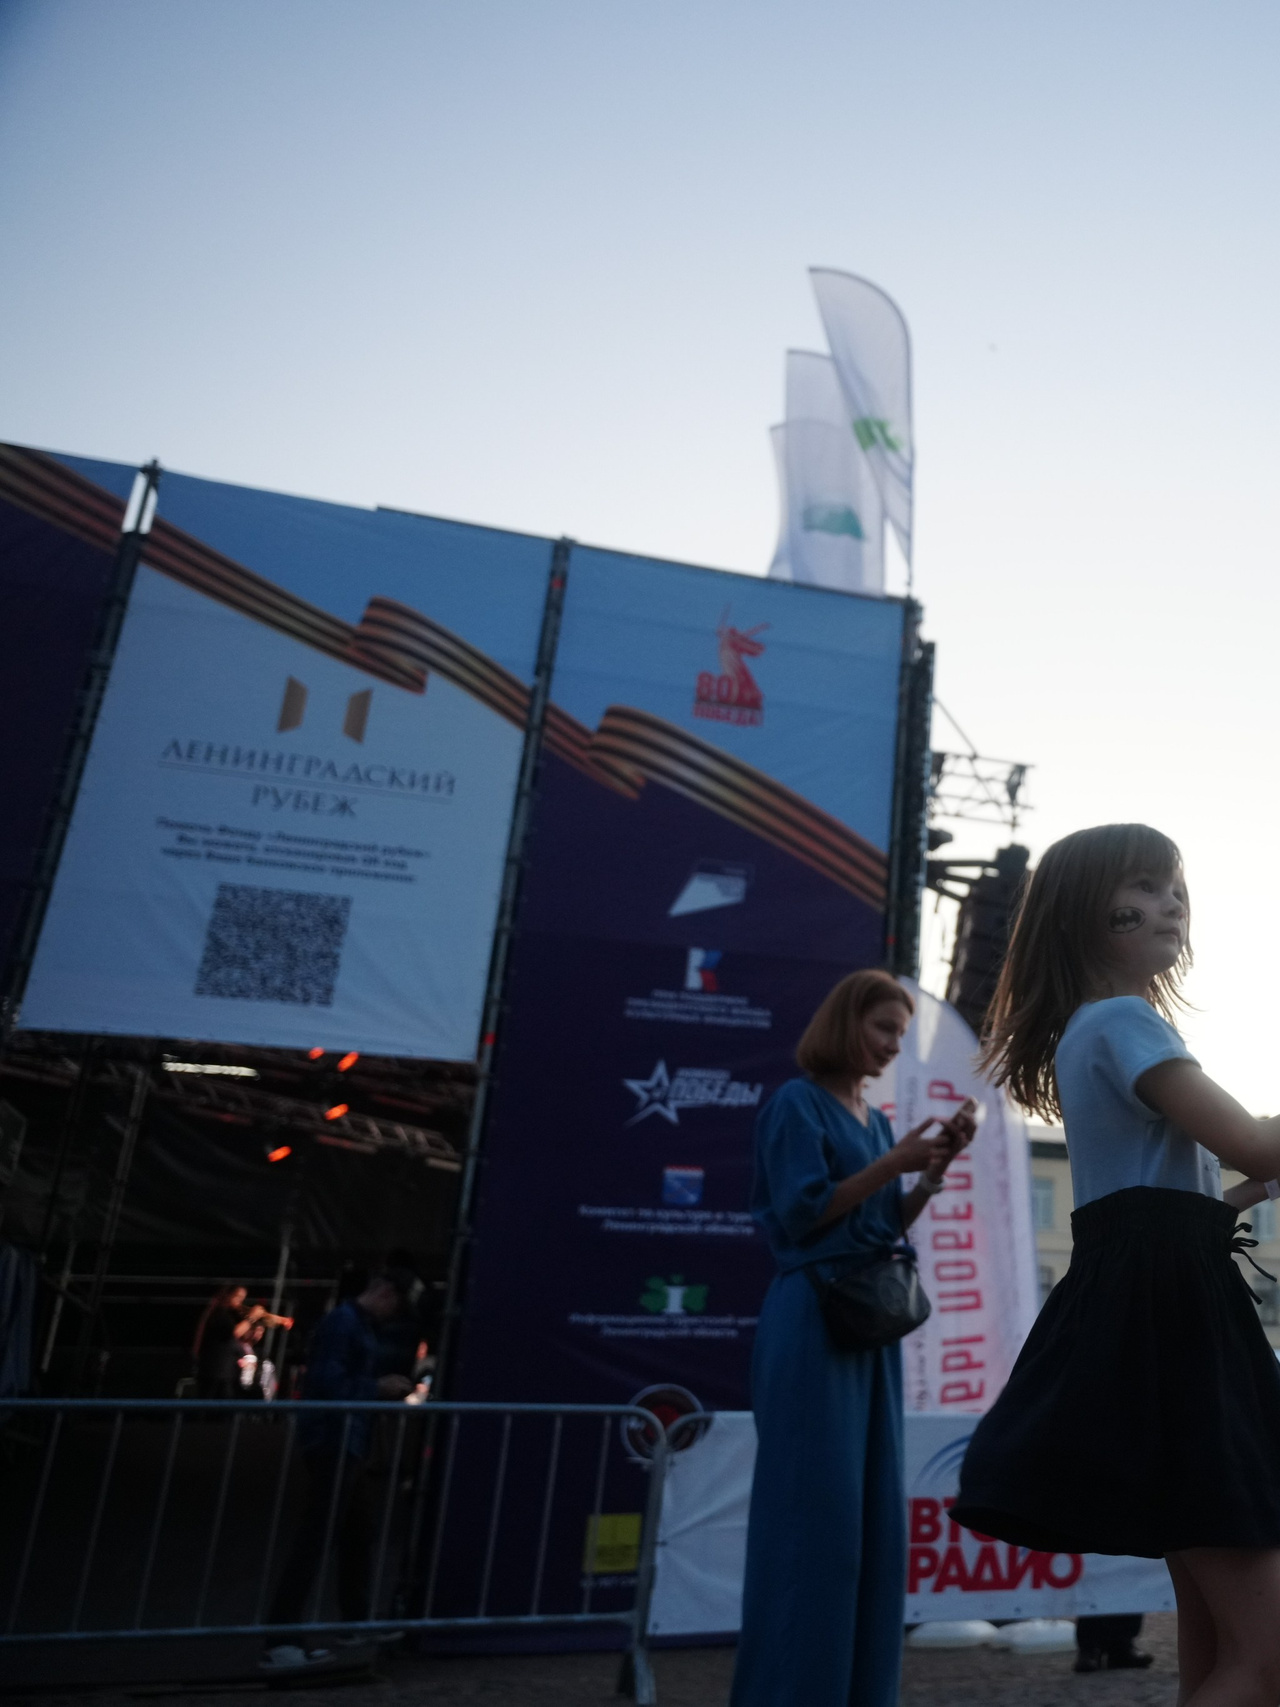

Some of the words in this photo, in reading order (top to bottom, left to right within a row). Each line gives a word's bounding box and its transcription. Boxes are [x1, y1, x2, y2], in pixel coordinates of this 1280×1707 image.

[161, 738, 456, 795] ЛЕНИНГРАДСКИЙ
[252, 784, 356, 817] РУБЕЖ
[906, 1545, 1084, 1594] РАДИО
